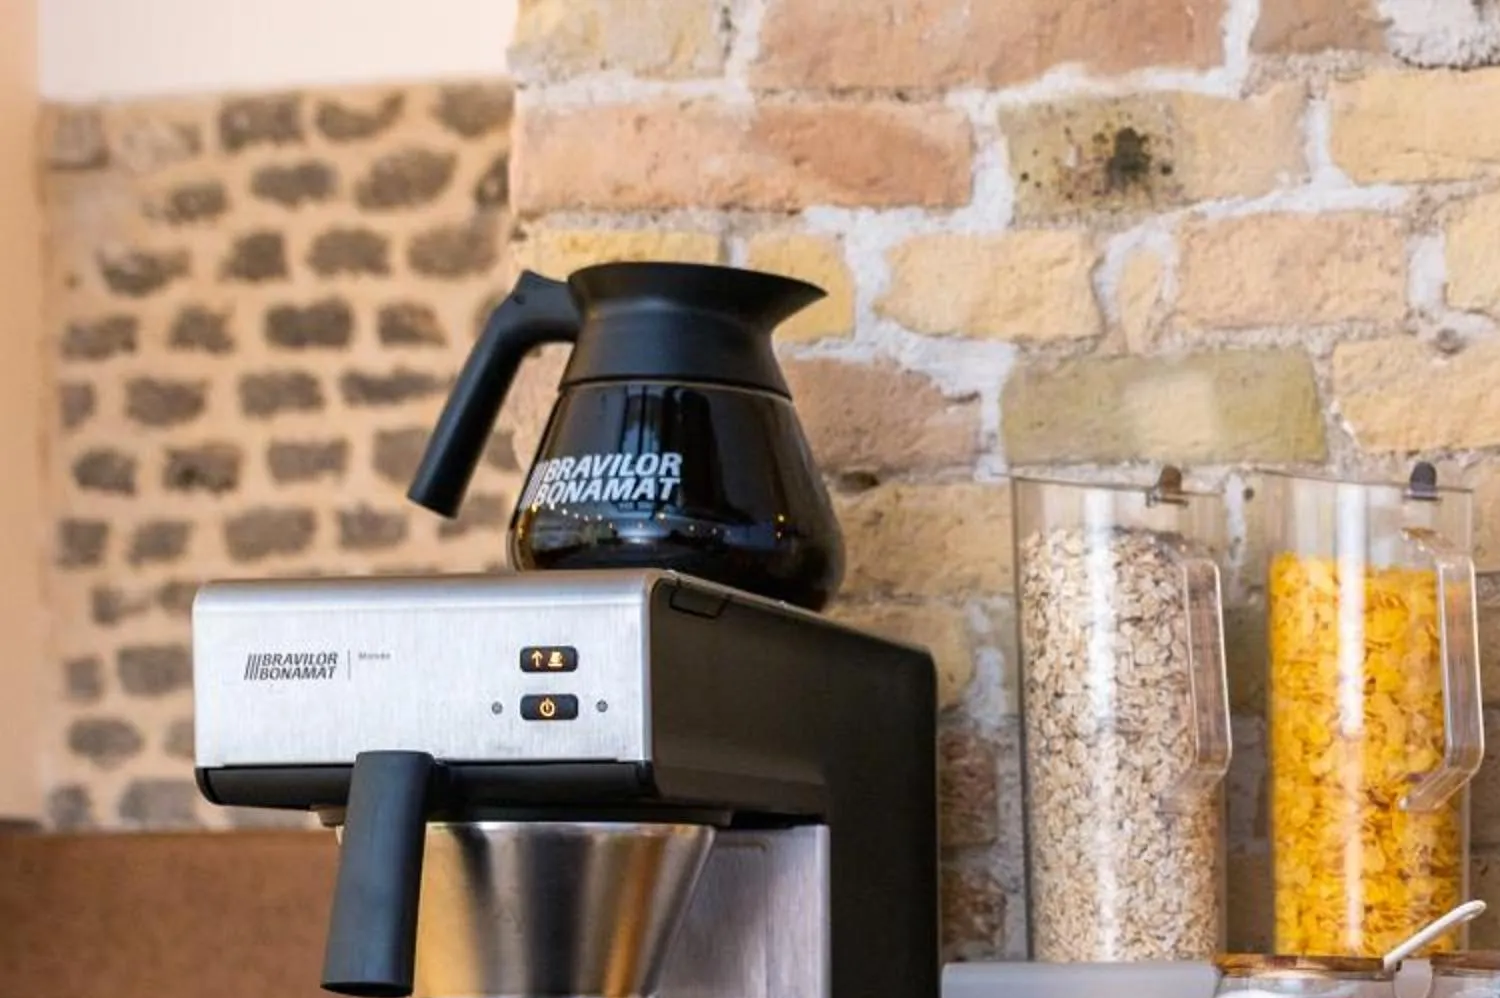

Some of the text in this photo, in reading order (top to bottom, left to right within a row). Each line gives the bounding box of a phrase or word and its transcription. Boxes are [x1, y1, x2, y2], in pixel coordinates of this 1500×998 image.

[544, 452, 682, 482] BRAVILOR
[534, 473, 681, 505] BONAMAT
[261, 652, 338, 666] BRAVILOR
[259, 666, 336, 680] BONAMAT
